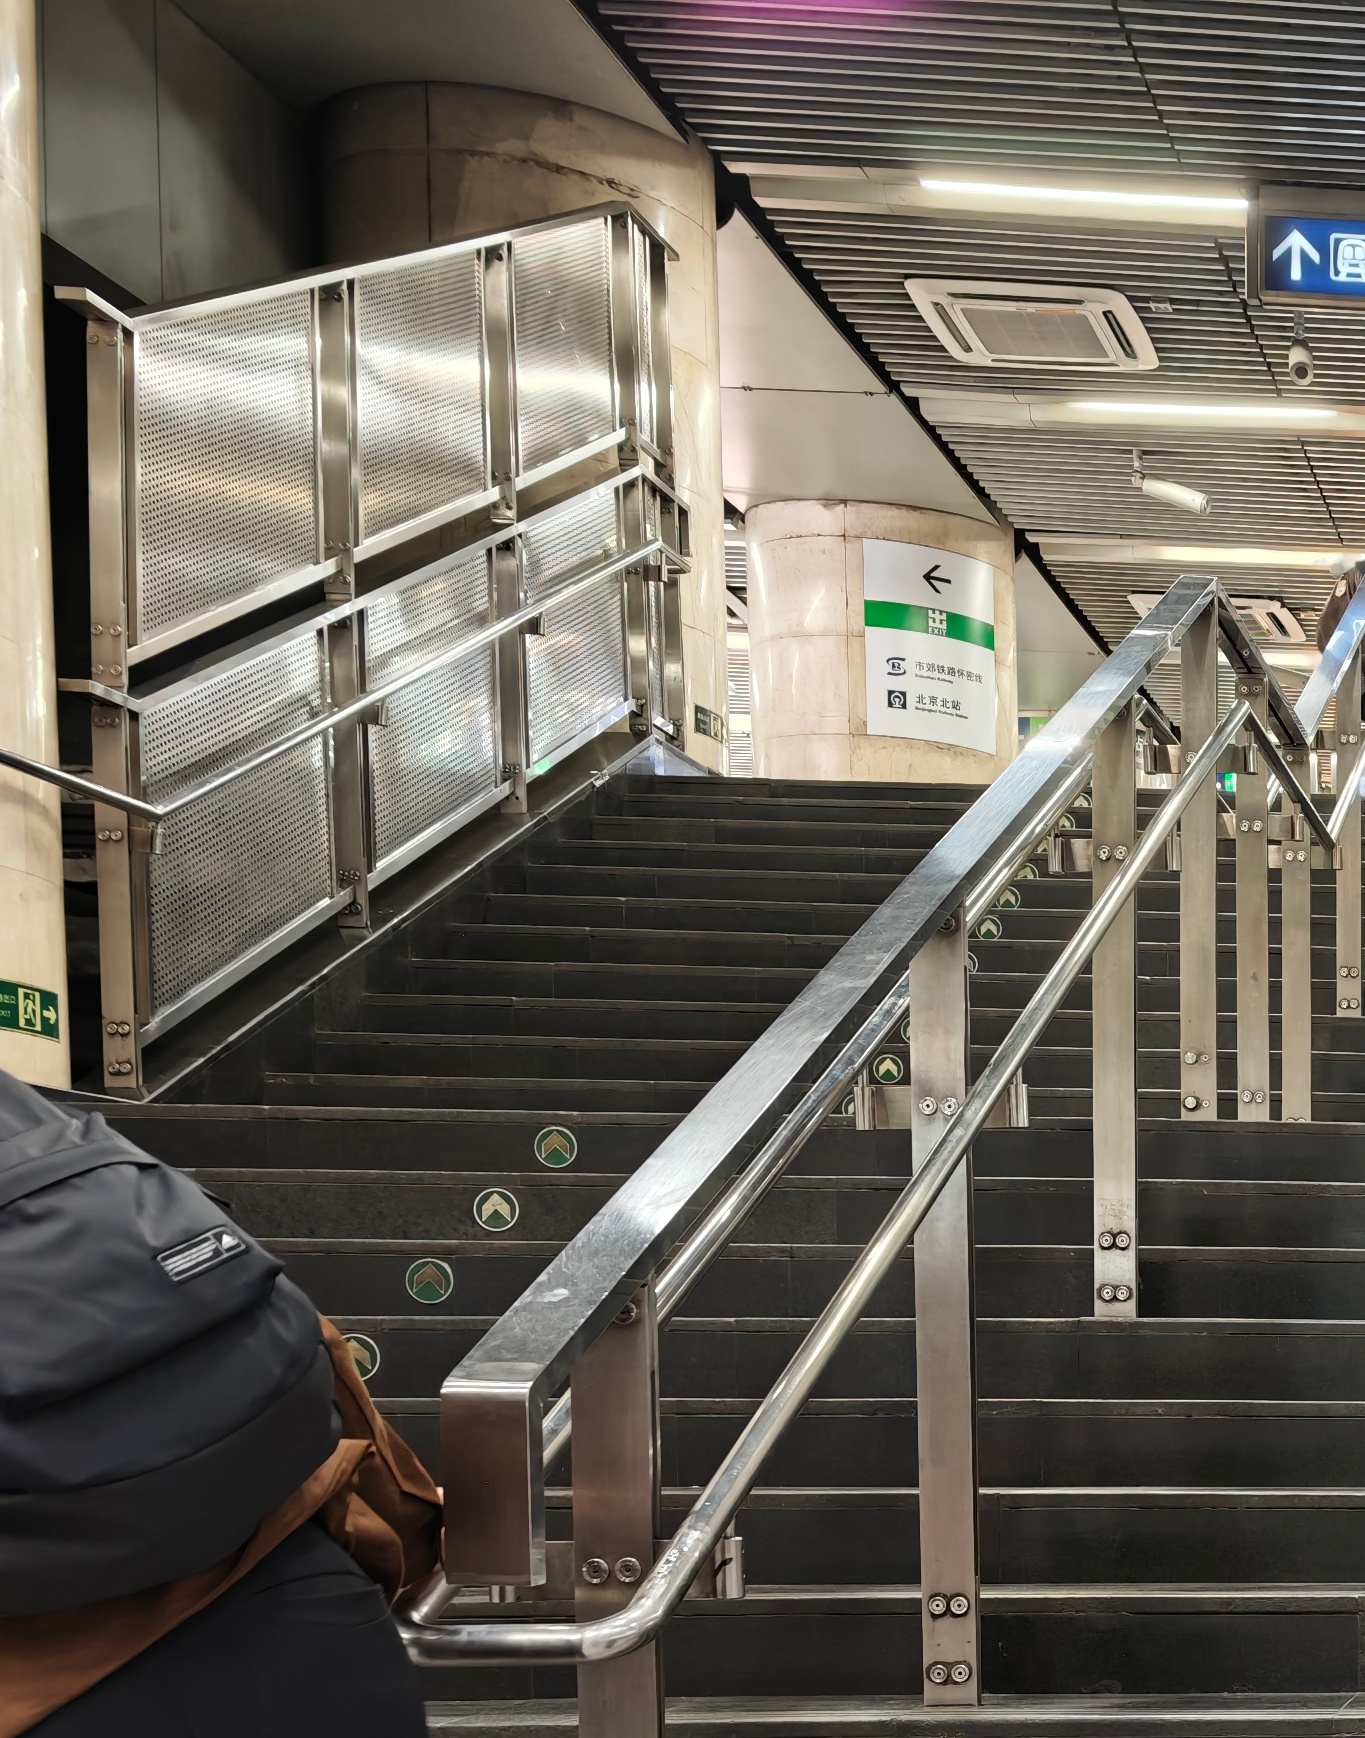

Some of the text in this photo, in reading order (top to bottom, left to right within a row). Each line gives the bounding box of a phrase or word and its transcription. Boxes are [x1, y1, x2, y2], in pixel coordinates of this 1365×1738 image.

[928, 627, 947, 637] EXIT
[915, 661, 983, 684] 市郊铁路怀密线
[915, 693, 962, 712] 北京北站
